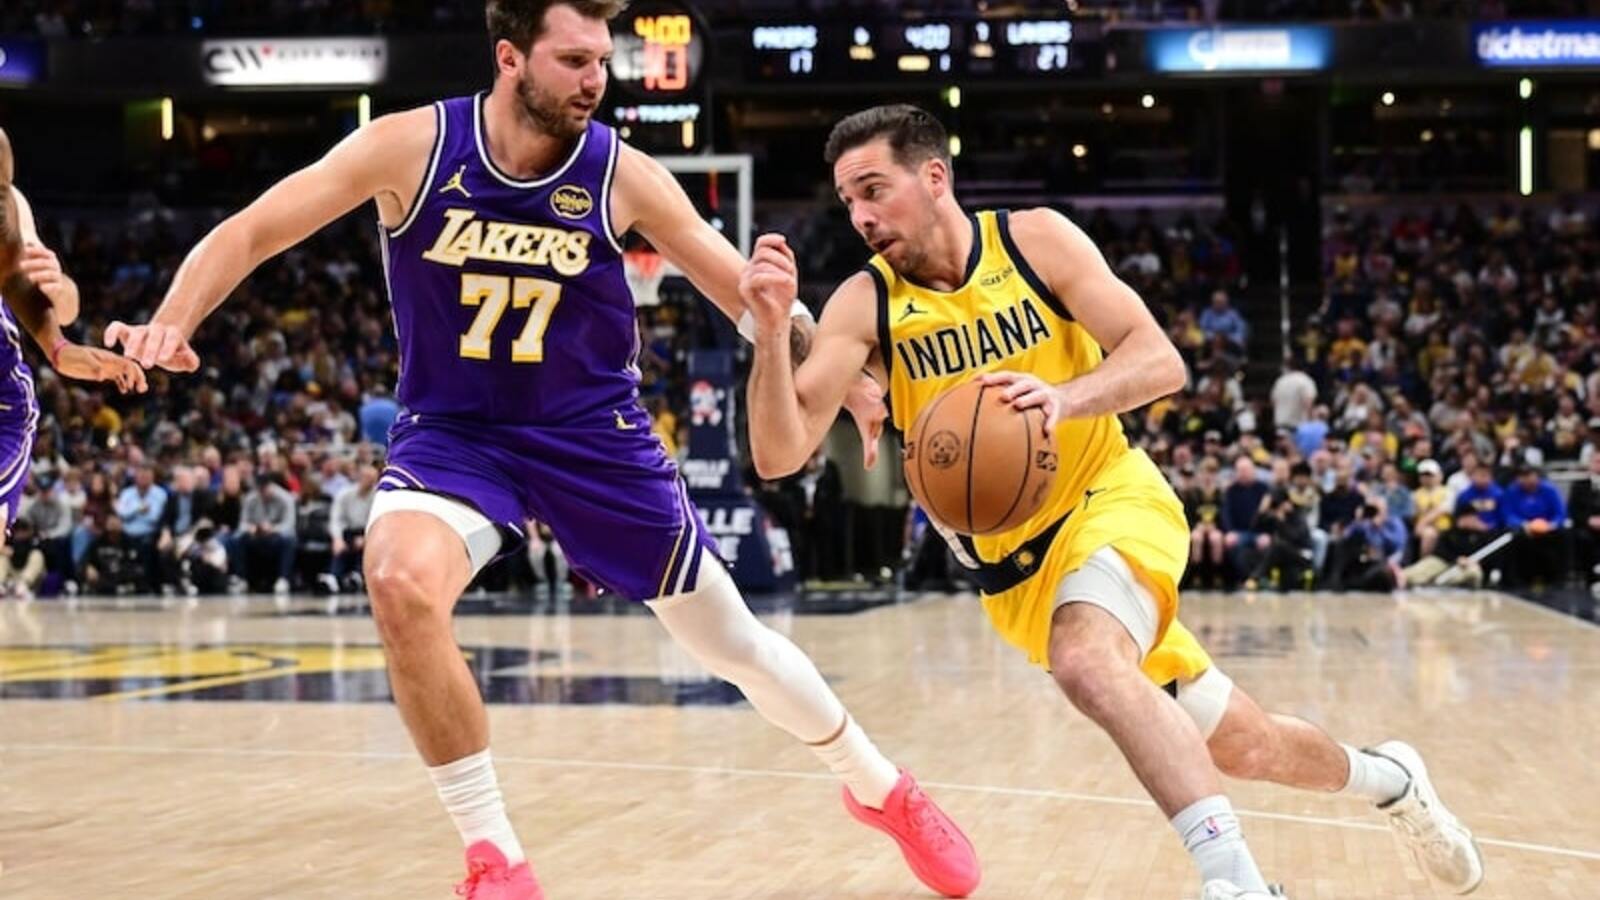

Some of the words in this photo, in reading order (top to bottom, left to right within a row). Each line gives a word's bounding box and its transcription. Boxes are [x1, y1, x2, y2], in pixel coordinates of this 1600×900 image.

[421, 208, 593, 277] LAKERS
[459, 272, 562, 363] 77
[896, 298, 1051, 381] INDIANA
